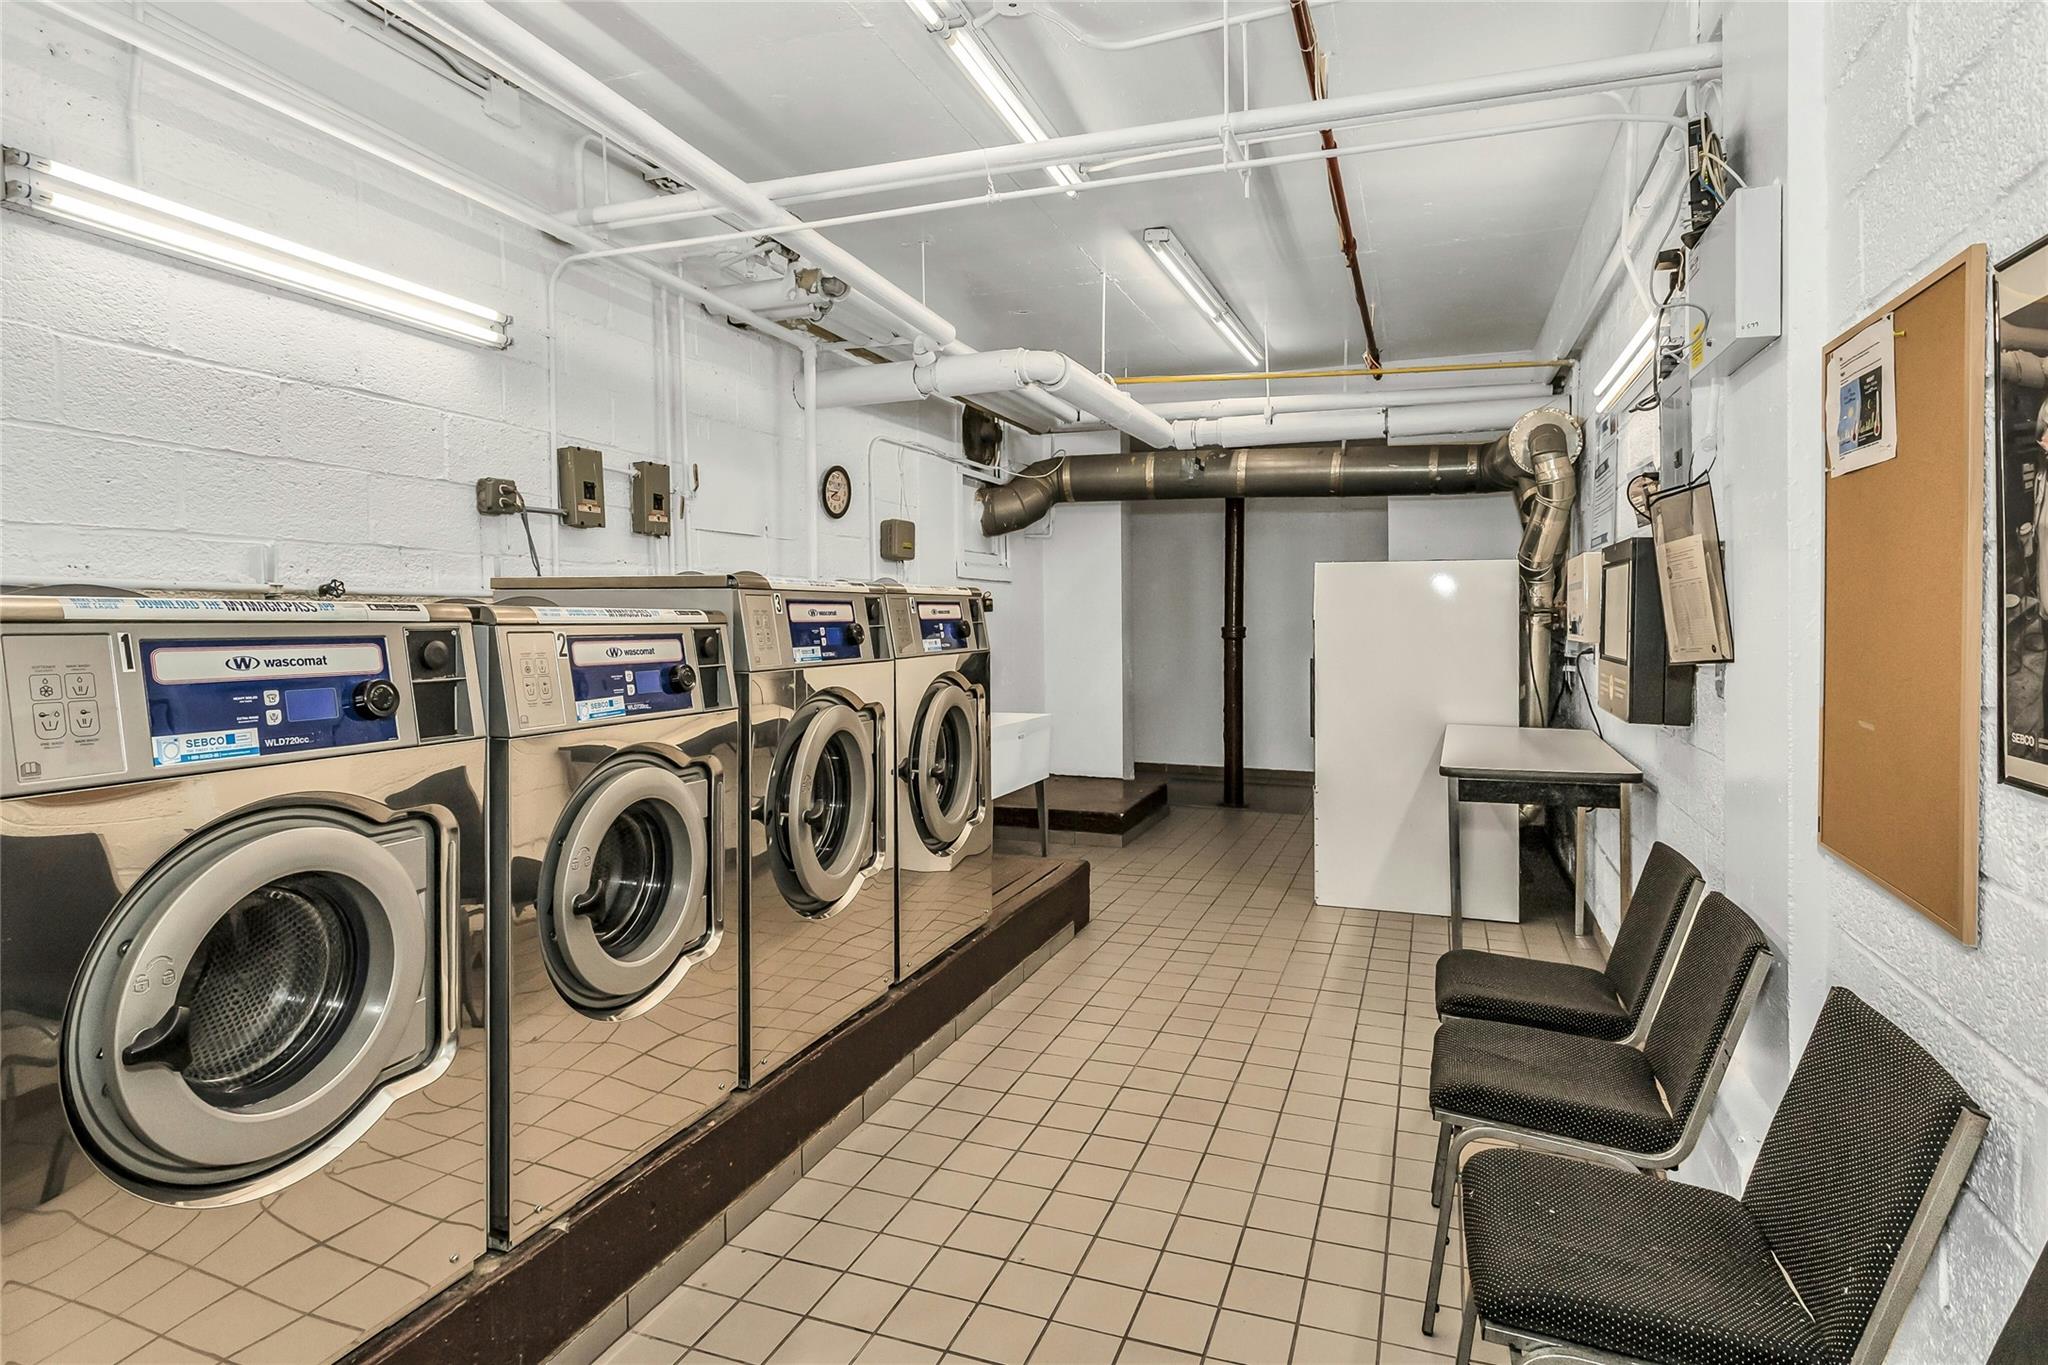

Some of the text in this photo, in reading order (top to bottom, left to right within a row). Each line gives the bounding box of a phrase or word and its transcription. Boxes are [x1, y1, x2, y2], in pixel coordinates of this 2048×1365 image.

[135, 599, 200, 610] DOWNLOAD
[202, 600, 224, 610] THE
[223, 600, 318, 612] MYMAGICPASS
[774, 594, 782, 612] 3
[557, 632, 567, 657] 2
[121, 634, 134, 669] 1
[624, 647, 655, 656] wascomat
[263, 655, 328, 668] wascomat
[185, 736, 225, 749] SEBCO
[265, 736, 310, 748] WLD720cc
[2011, 731, 2034, 746] SEBCO
